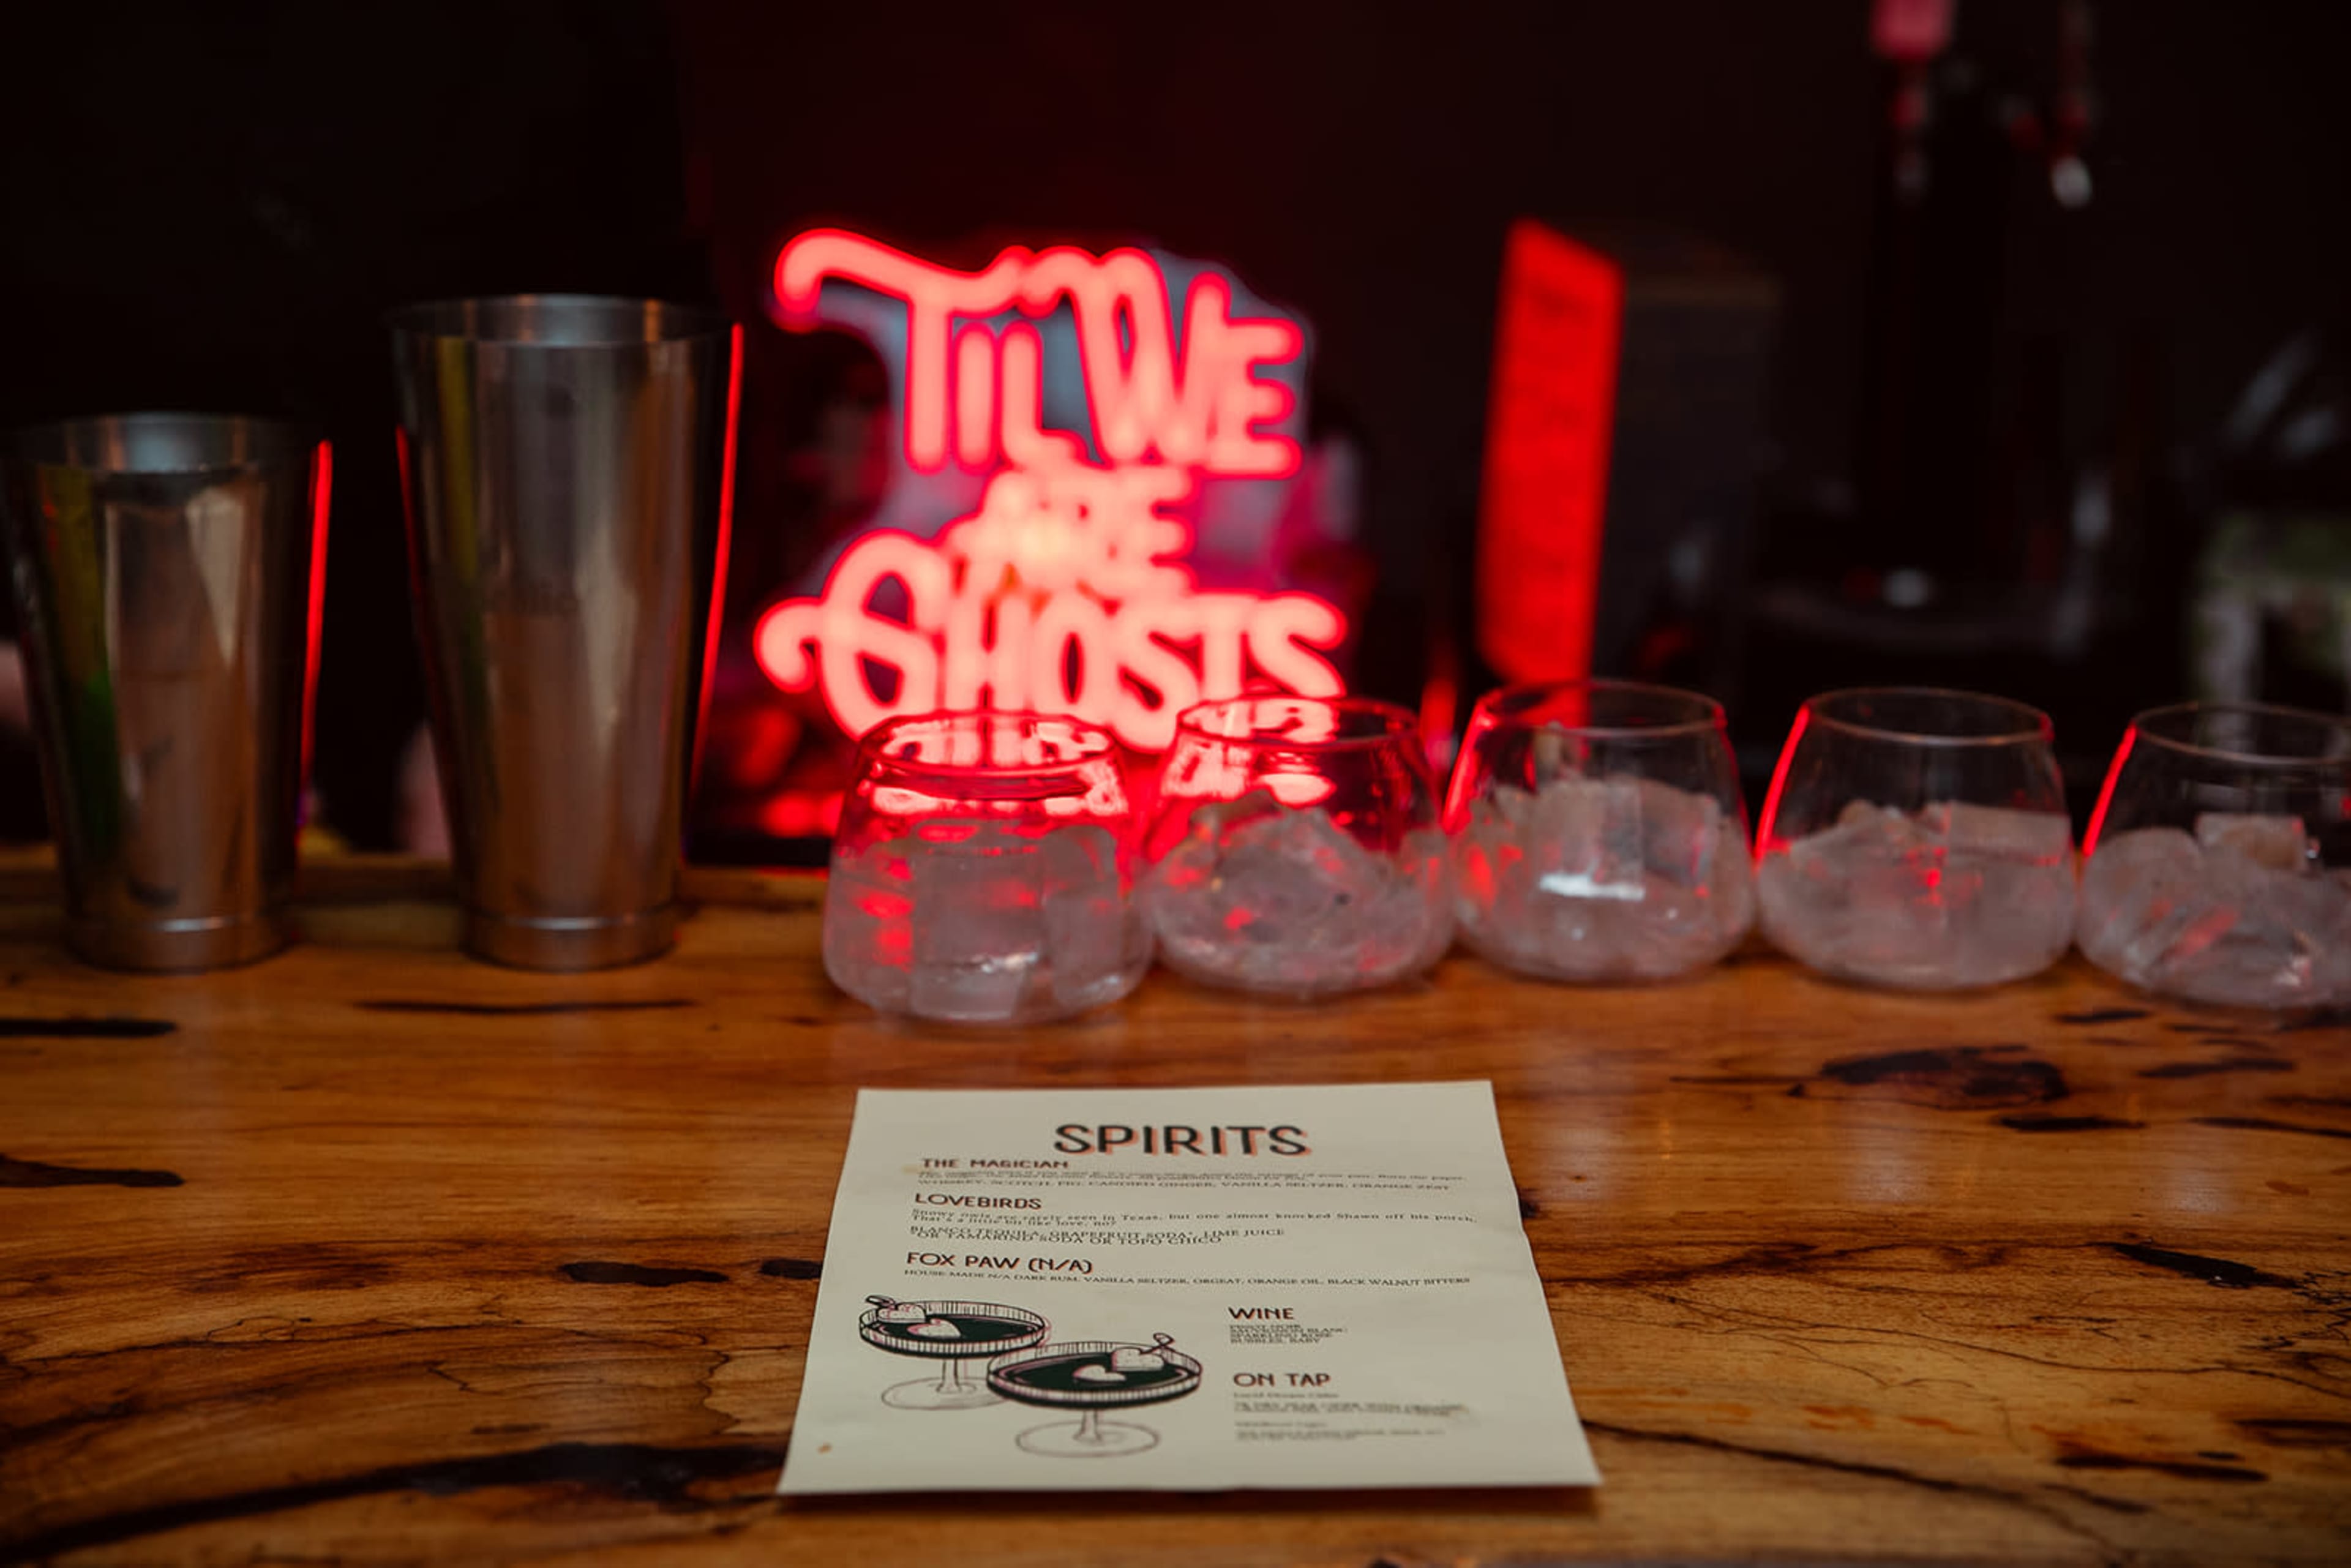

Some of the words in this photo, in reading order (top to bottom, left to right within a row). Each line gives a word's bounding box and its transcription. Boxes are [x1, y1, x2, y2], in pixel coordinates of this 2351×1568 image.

[1018, 244, 1303, 479] WE
[946, 464, 1197, 603] ARE
[754, 528, 1347, 752] GHOSTS
[1054, 1123, 1312, 1158] SPIRITS
[923, 1158, 959, 1169] THE
[970, 1158, 1070, 1169] MAGICIAN
[915, 1193, 1043, 1210] LOVEBIRDS
[907, 1251, 956, 1267] FOX
[966, 1255, 1021, 1270] PAW
[1028, 1257, 1094, 1275] (N/A)
[1228, 1306, 1294, 1321] WINE
[1233, 1371, 1275, 1388] ON
[1285, 1372, 1332, 1388] TAP
